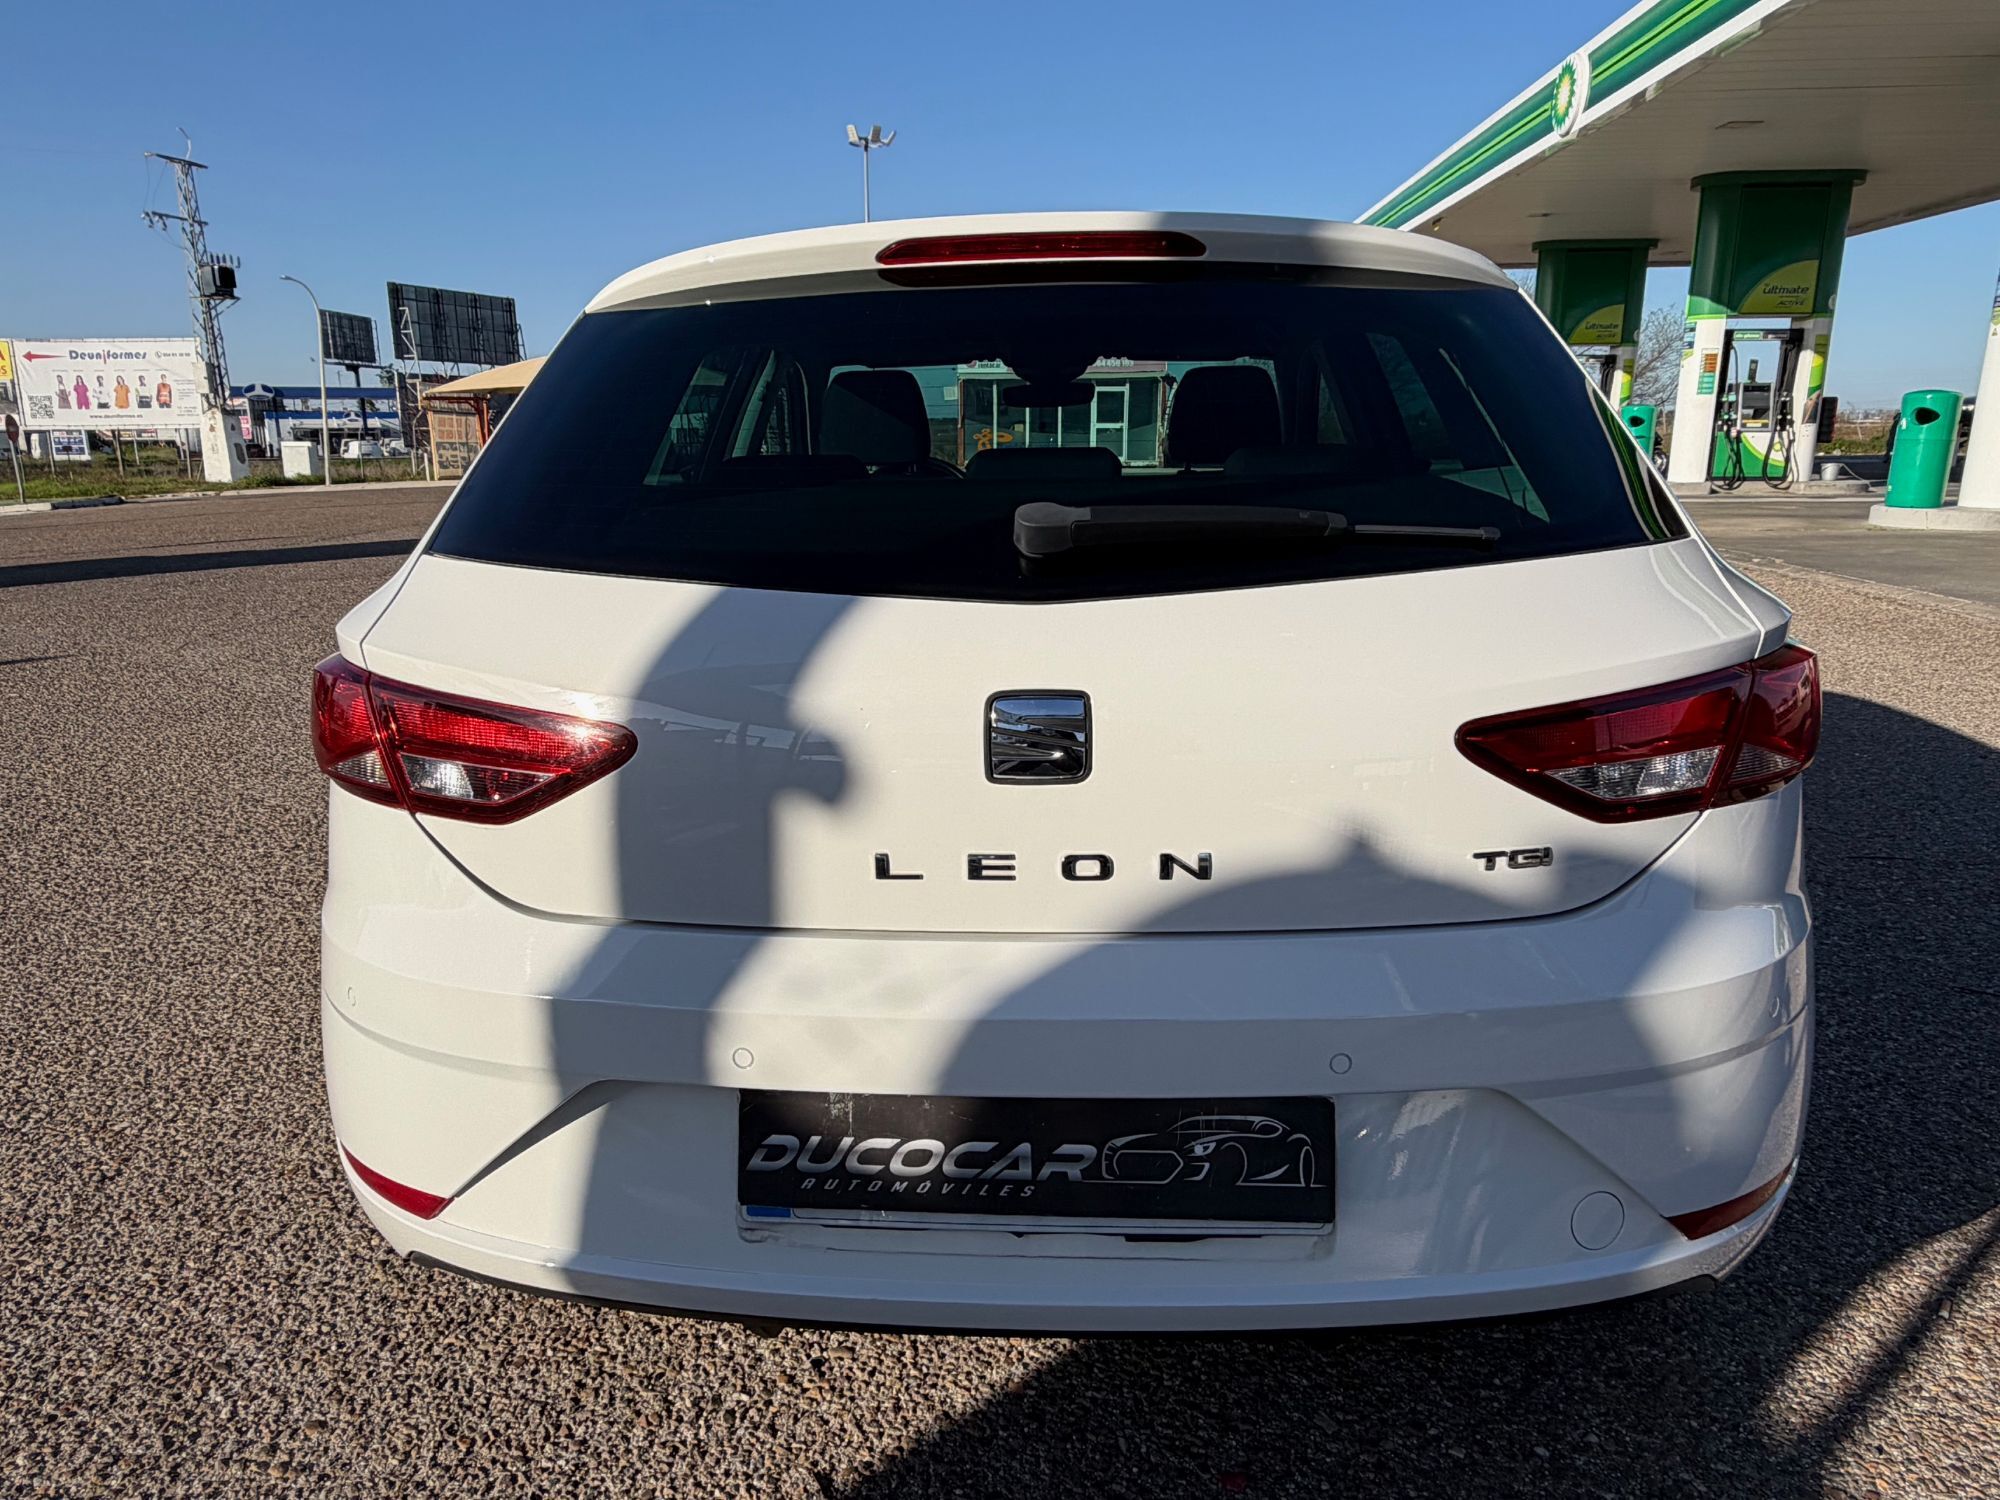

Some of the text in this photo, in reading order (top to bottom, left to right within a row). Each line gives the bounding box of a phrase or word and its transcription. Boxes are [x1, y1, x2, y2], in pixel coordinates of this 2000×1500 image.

[68, 349, 147, 364] Deuniformes
[874, 851, 1213, 881] LEON
[1472, 846, 1554, 872] TGI
[745, 1133, 1098, 1182] DUCOCAR
[800, 1178, 1037, 1197] AUTOMÓVILES
